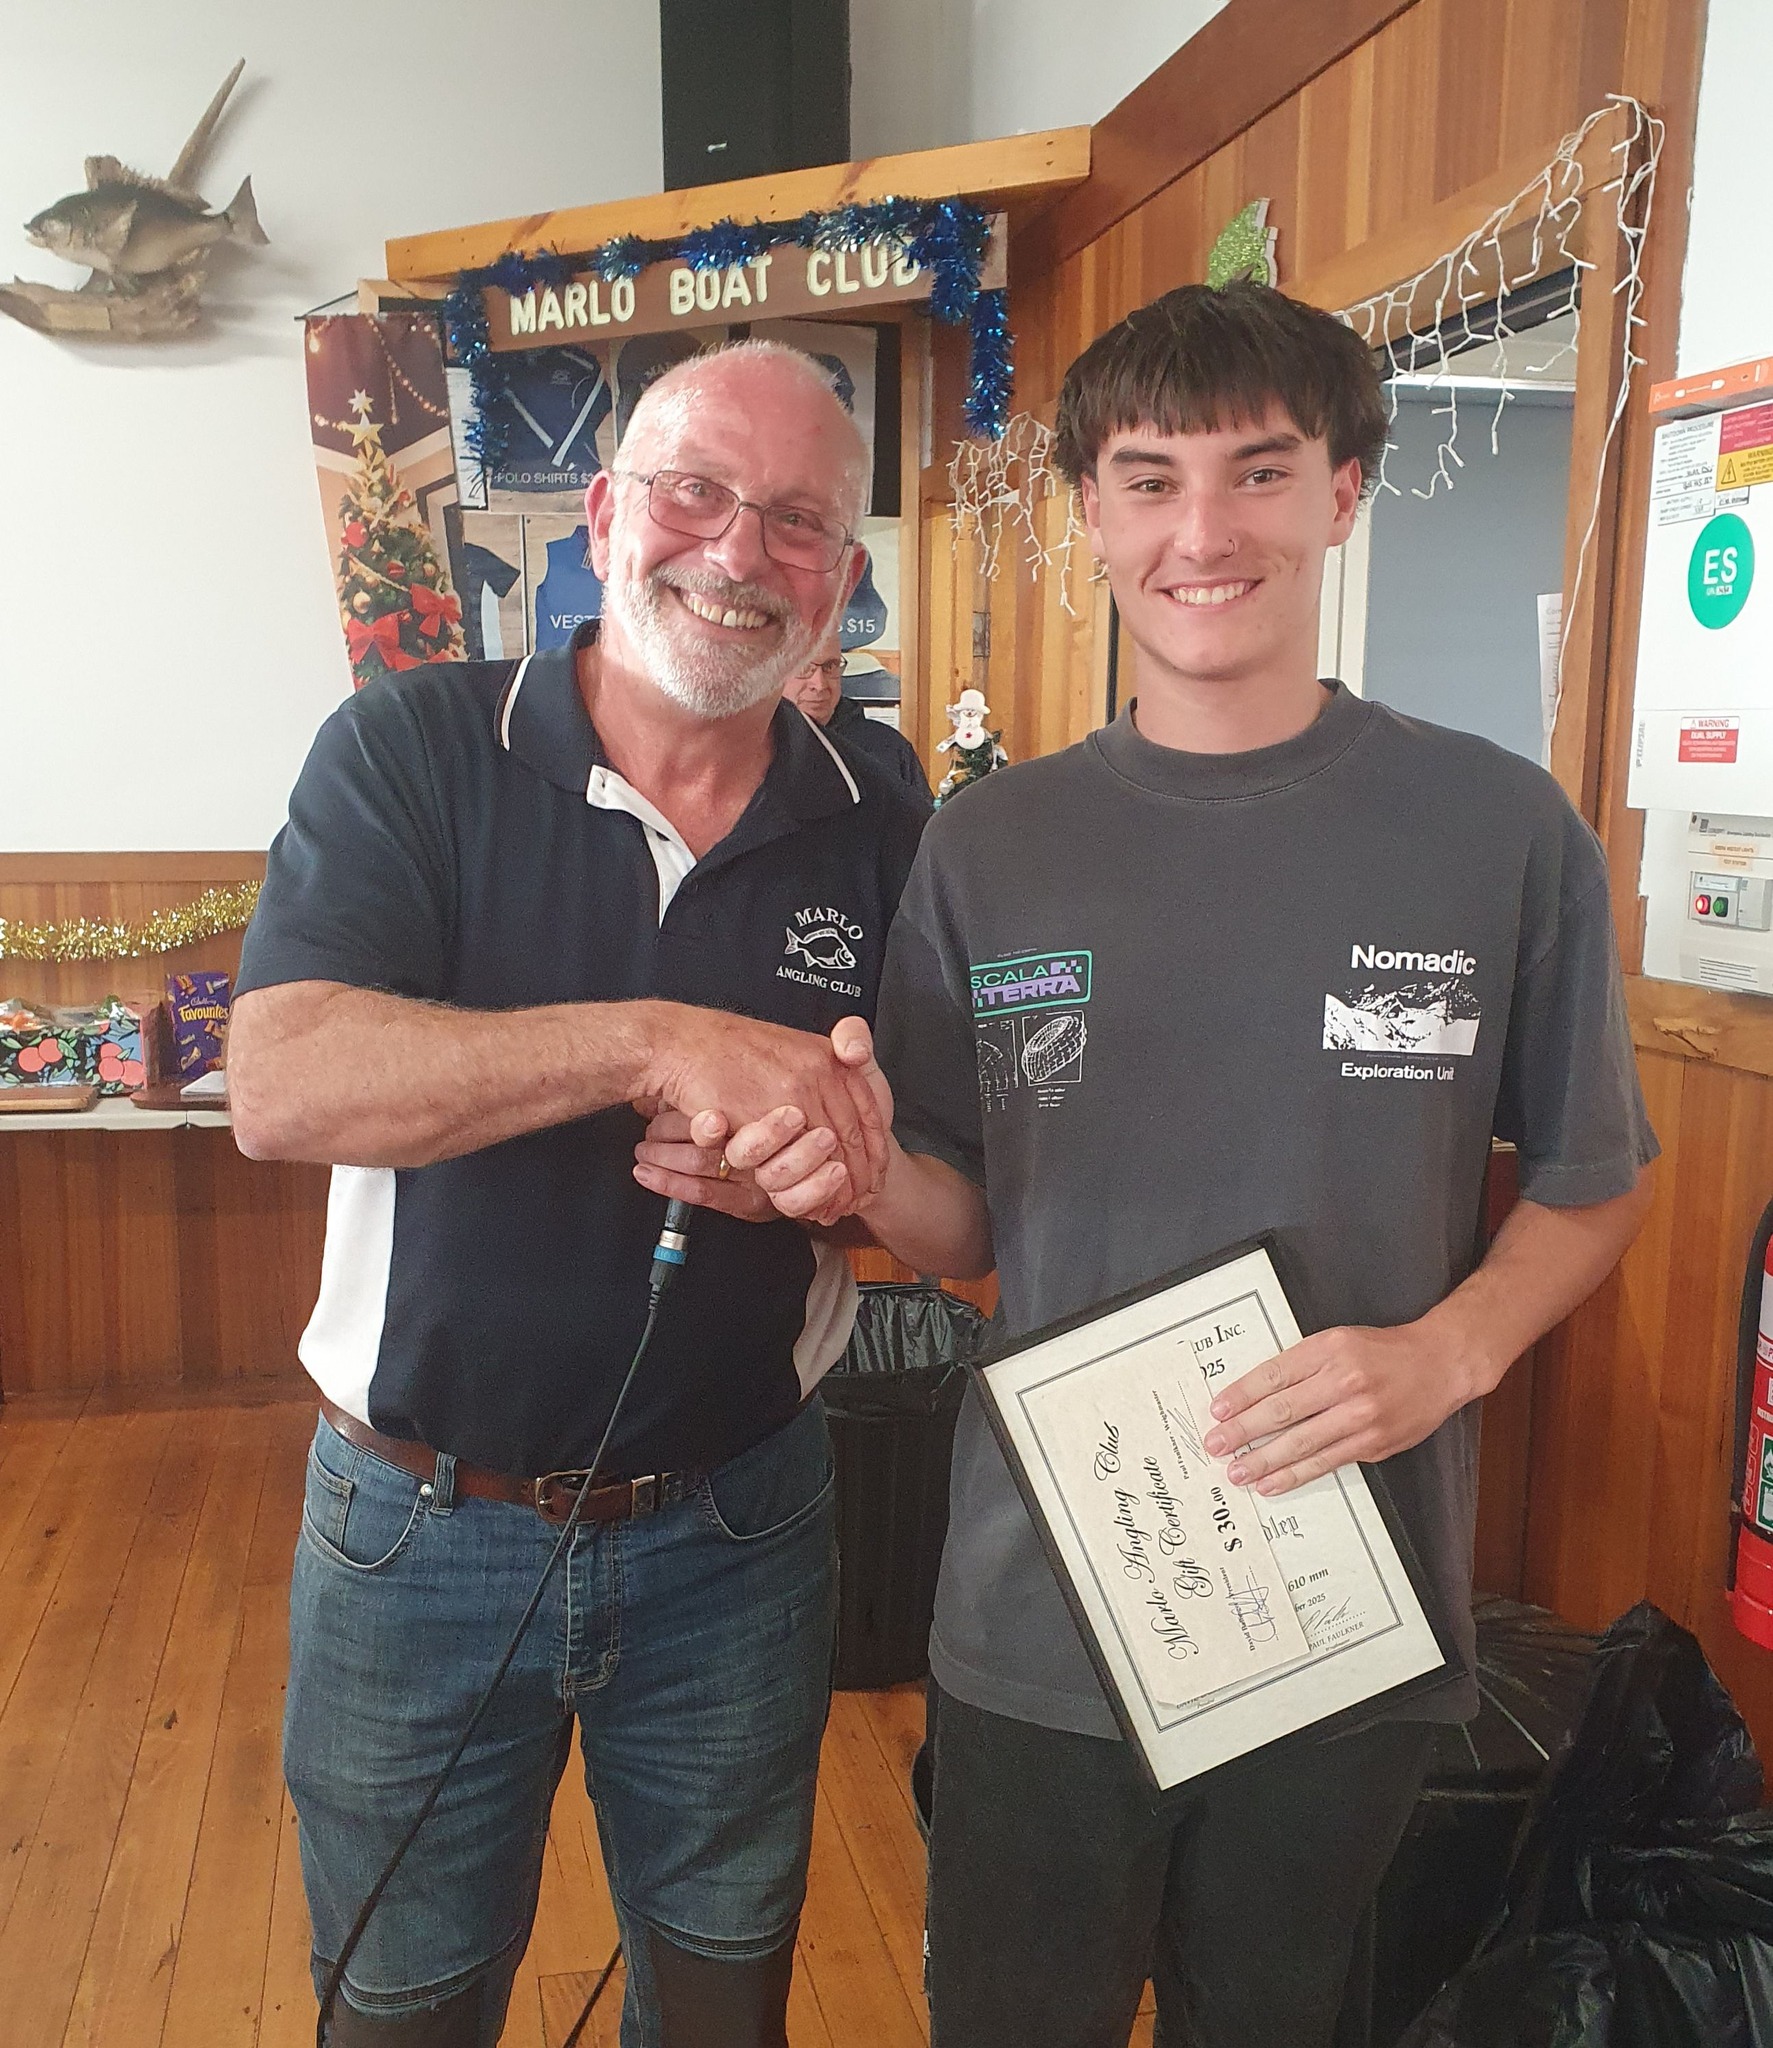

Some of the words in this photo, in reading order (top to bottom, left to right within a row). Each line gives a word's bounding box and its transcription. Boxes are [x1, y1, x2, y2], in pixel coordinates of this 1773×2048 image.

[510, 276, 636, 336] MARLO
[669, 253, 773, 316] BOAT
[806, 242, 920, 297] CLUB
[497, 472, 532, 484] POLO
[533, 472, 579, 484] SHIRTS
[1703, 546, 1738, 585] ES
[549, 613, 605, 630] VES
[846, 617, 876, 634] $15
[1698, 719, 1730, 728] WARNING
[794, 906, 864, 940] MARLO
[1350, 944, 1477, 975] Nomadic
[775, 965, 828, 988] ANGLING
[829, 980, 862, 998] CLUB
[970, 964, 1049, 989] SCALA
[980, 974, 1081, 1006] TERRA
[178, 1003, 230, 1023] Favourites
[1341, 1062, 1434, 1081] Exploration
[1193, 1336, 1214, 1355] UB
[1093, 1421, 1121, 1482] Club
[1143, 1454, 1187, 1557] Certificate
[1113, 1487, 1156, 1584] Angling
[1172, 1557, 1214, 1600] Gift
[1286, 1575, 1306, 1593] 610
[1308, 1567, 1330, 1583] mm
[1306, 1592, 1327, 1608] 2025
[1146, 1587, 1200, 1661] Marlo
[1326, 1620, 1365, 1643] FAULKNER
